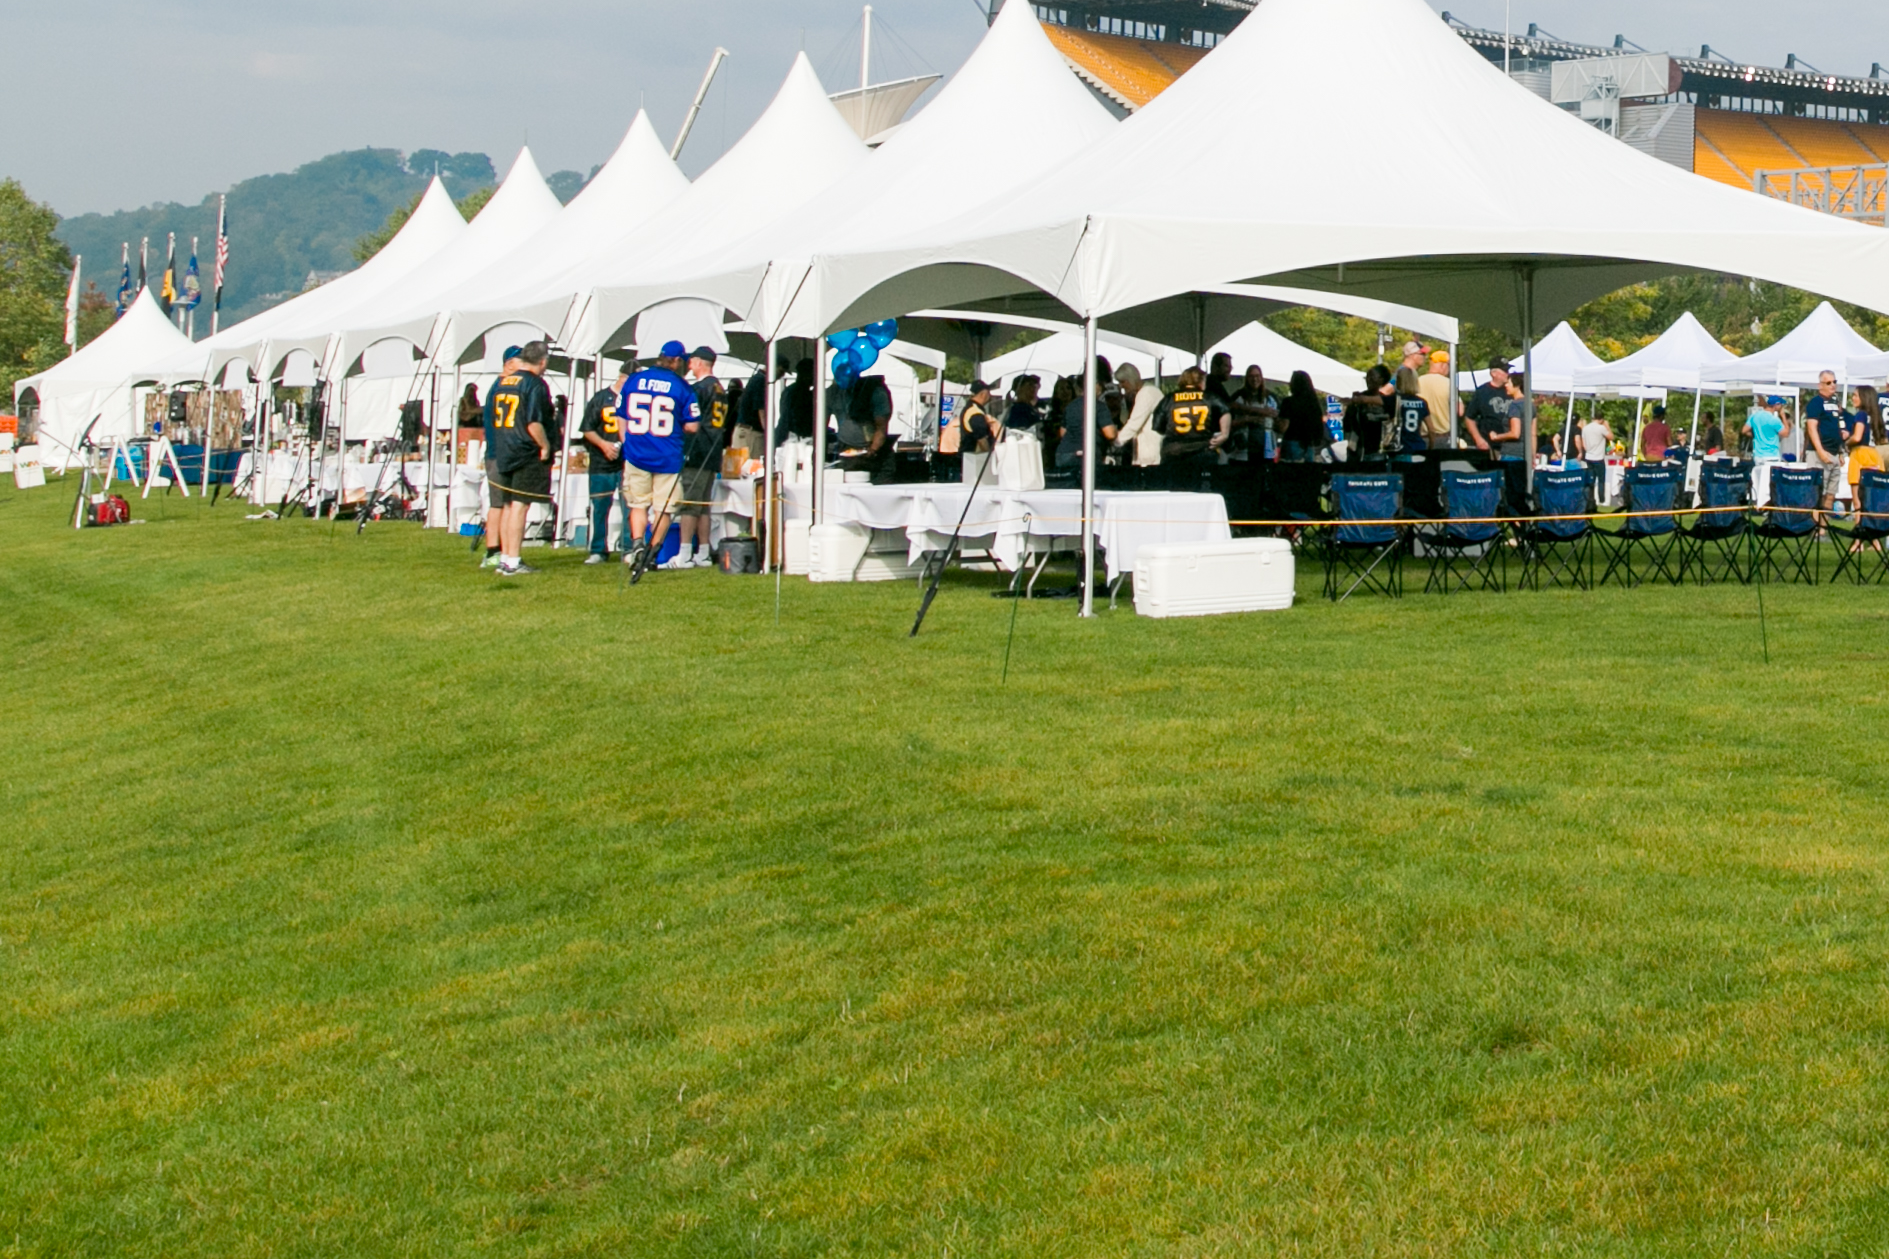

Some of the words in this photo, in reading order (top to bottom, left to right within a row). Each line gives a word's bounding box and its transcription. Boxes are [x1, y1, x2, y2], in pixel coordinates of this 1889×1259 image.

[494, 394, 519, 428] 57
[602, 406, 619, 433] 5
[628, 393, 675, 437] 56
[1173, 406, 1209, 434] 57
[1405, 410, 1418, 432] 8
